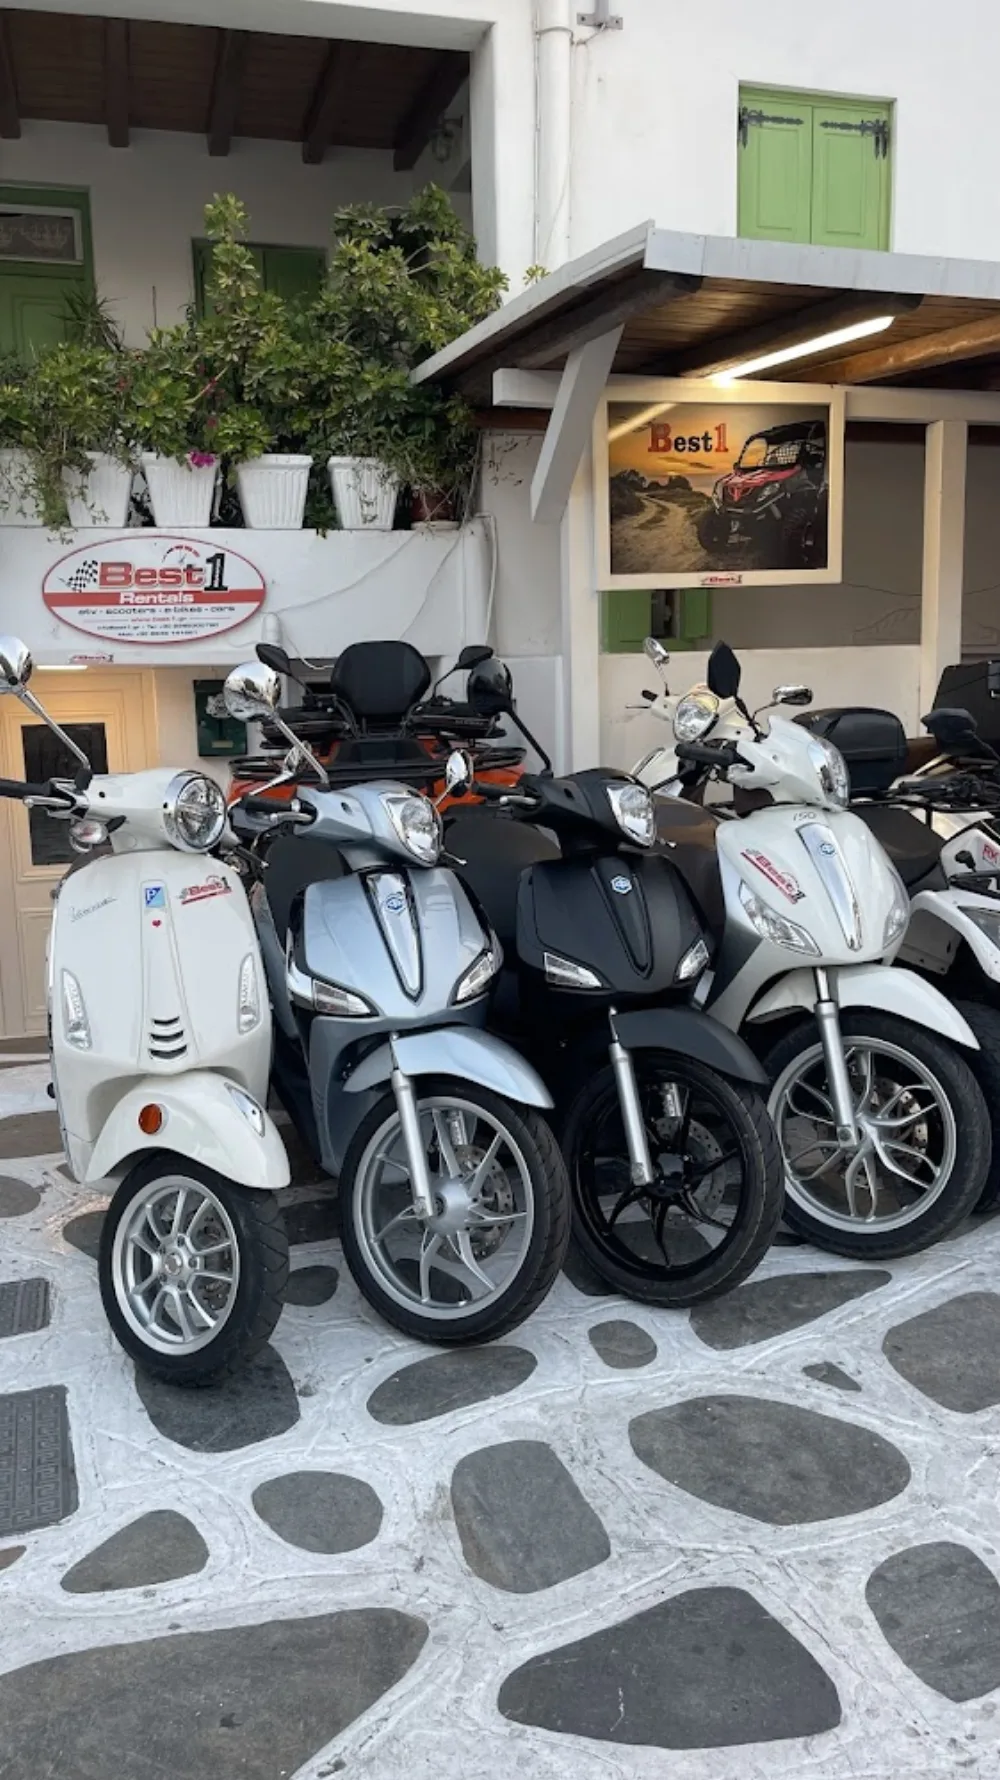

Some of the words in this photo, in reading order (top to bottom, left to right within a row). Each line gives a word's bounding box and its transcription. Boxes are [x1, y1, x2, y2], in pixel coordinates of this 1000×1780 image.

[648, 423, 729, 453] Best1
[100, 553, 228, 592] Best1
[119, 592, 195, 605] Rentals
[793, 811, 817, 821] 150
